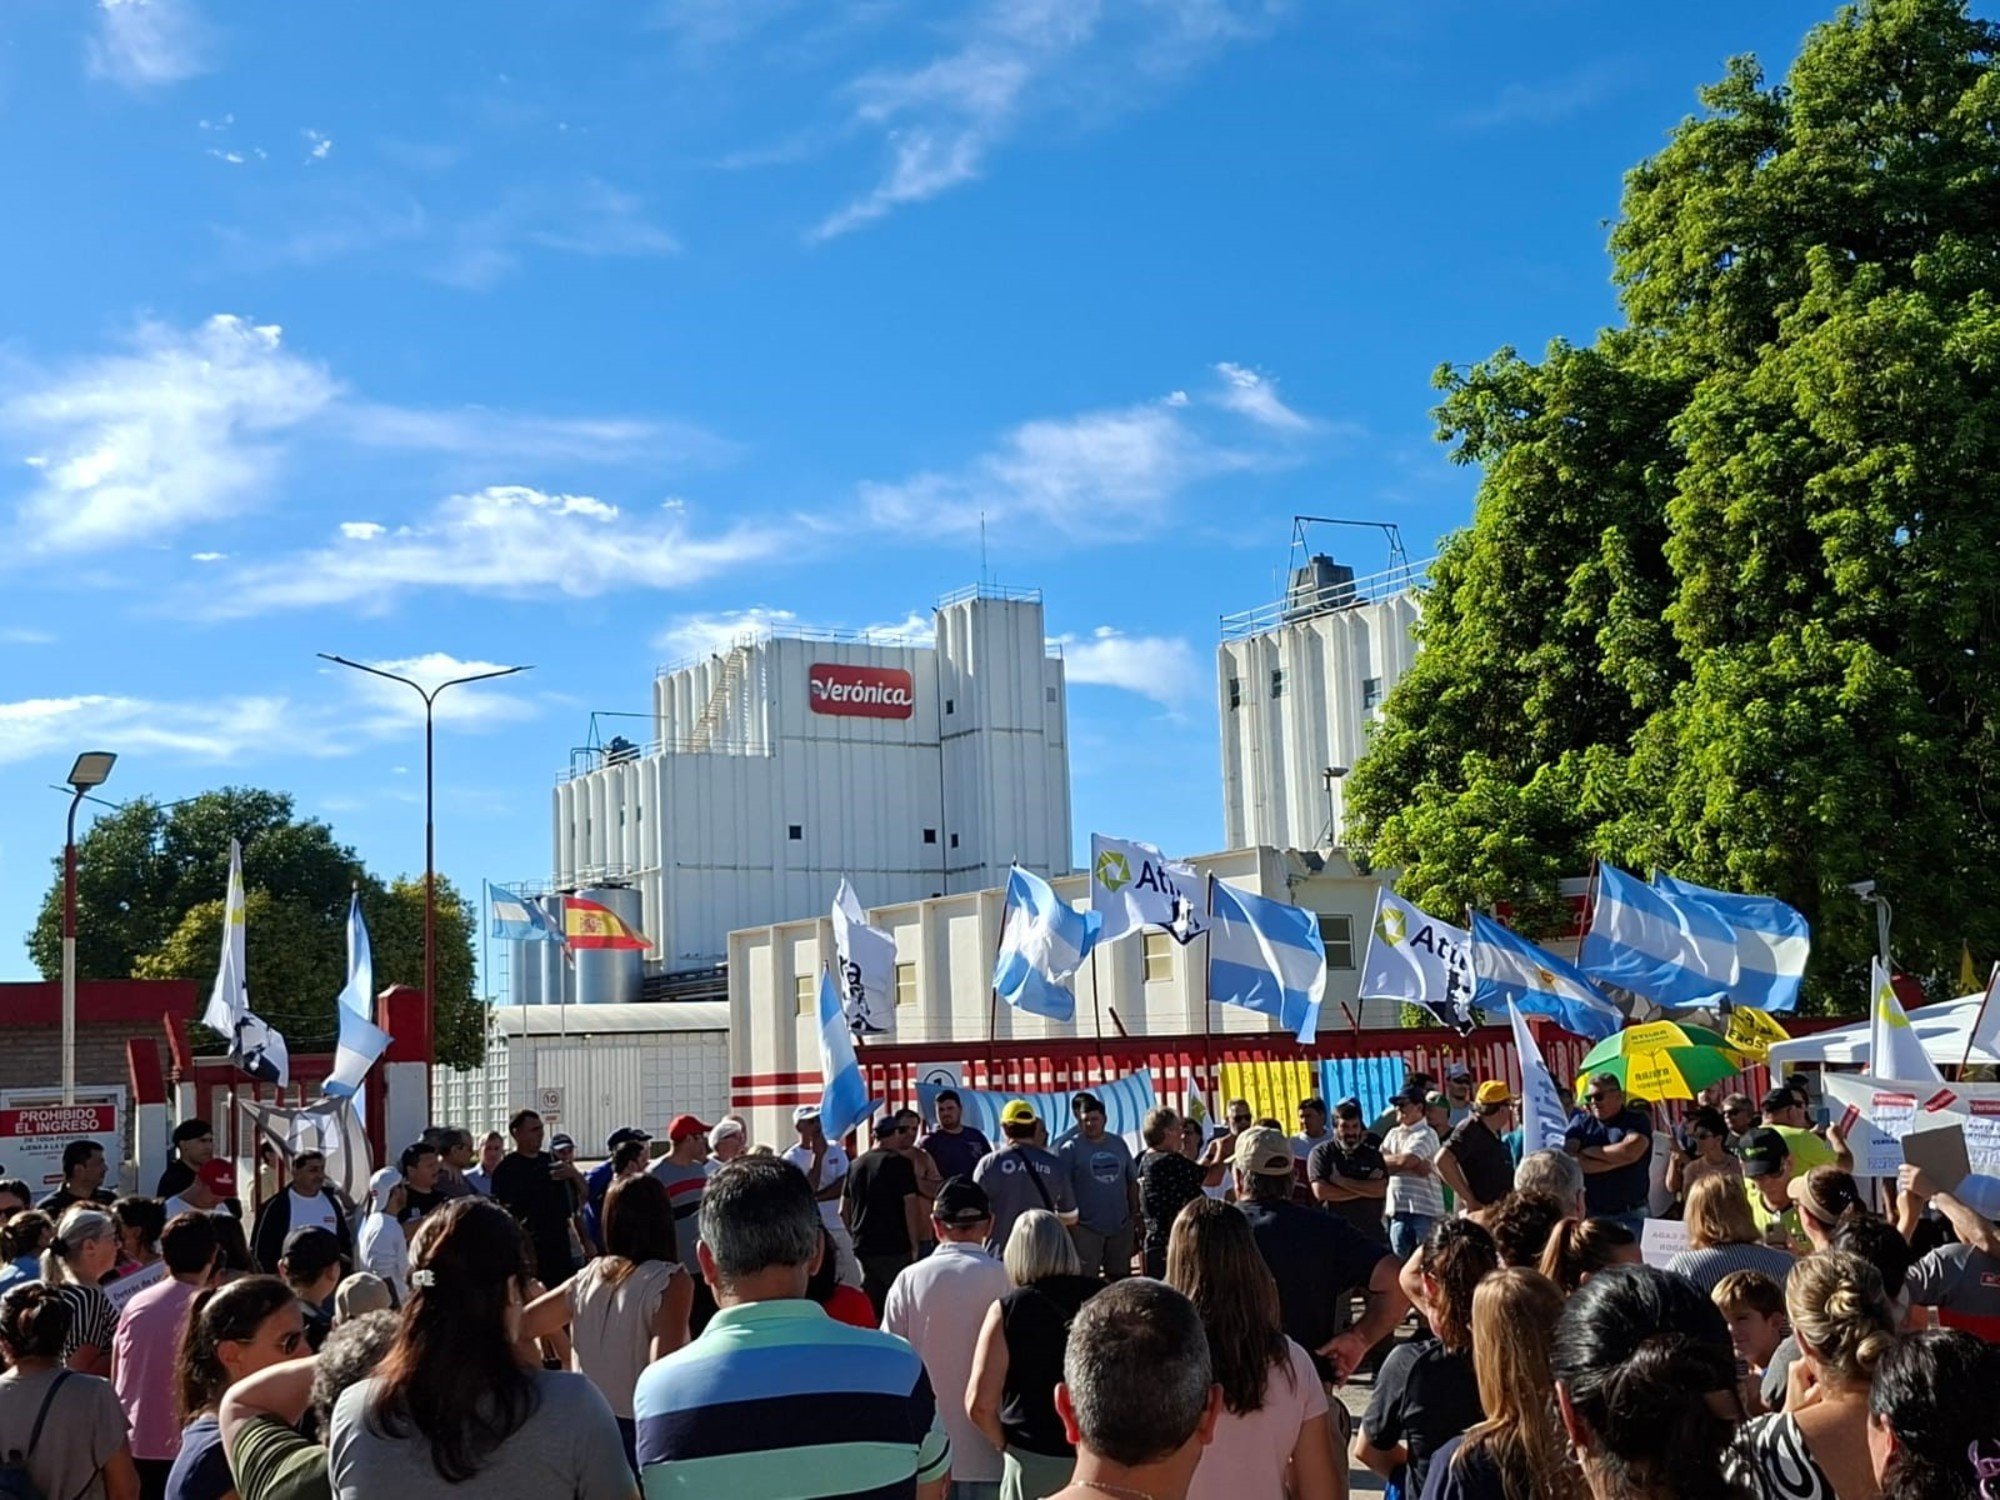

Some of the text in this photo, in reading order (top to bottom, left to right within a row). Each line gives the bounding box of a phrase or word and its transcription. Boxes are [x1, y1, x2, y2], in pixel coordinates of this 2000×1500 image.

[811, 677, 912, 705] Verónica
[20, 1108, 96, 1122] PROHIBIDO
[15, 1118, 99, 1134] EL INGRESO
